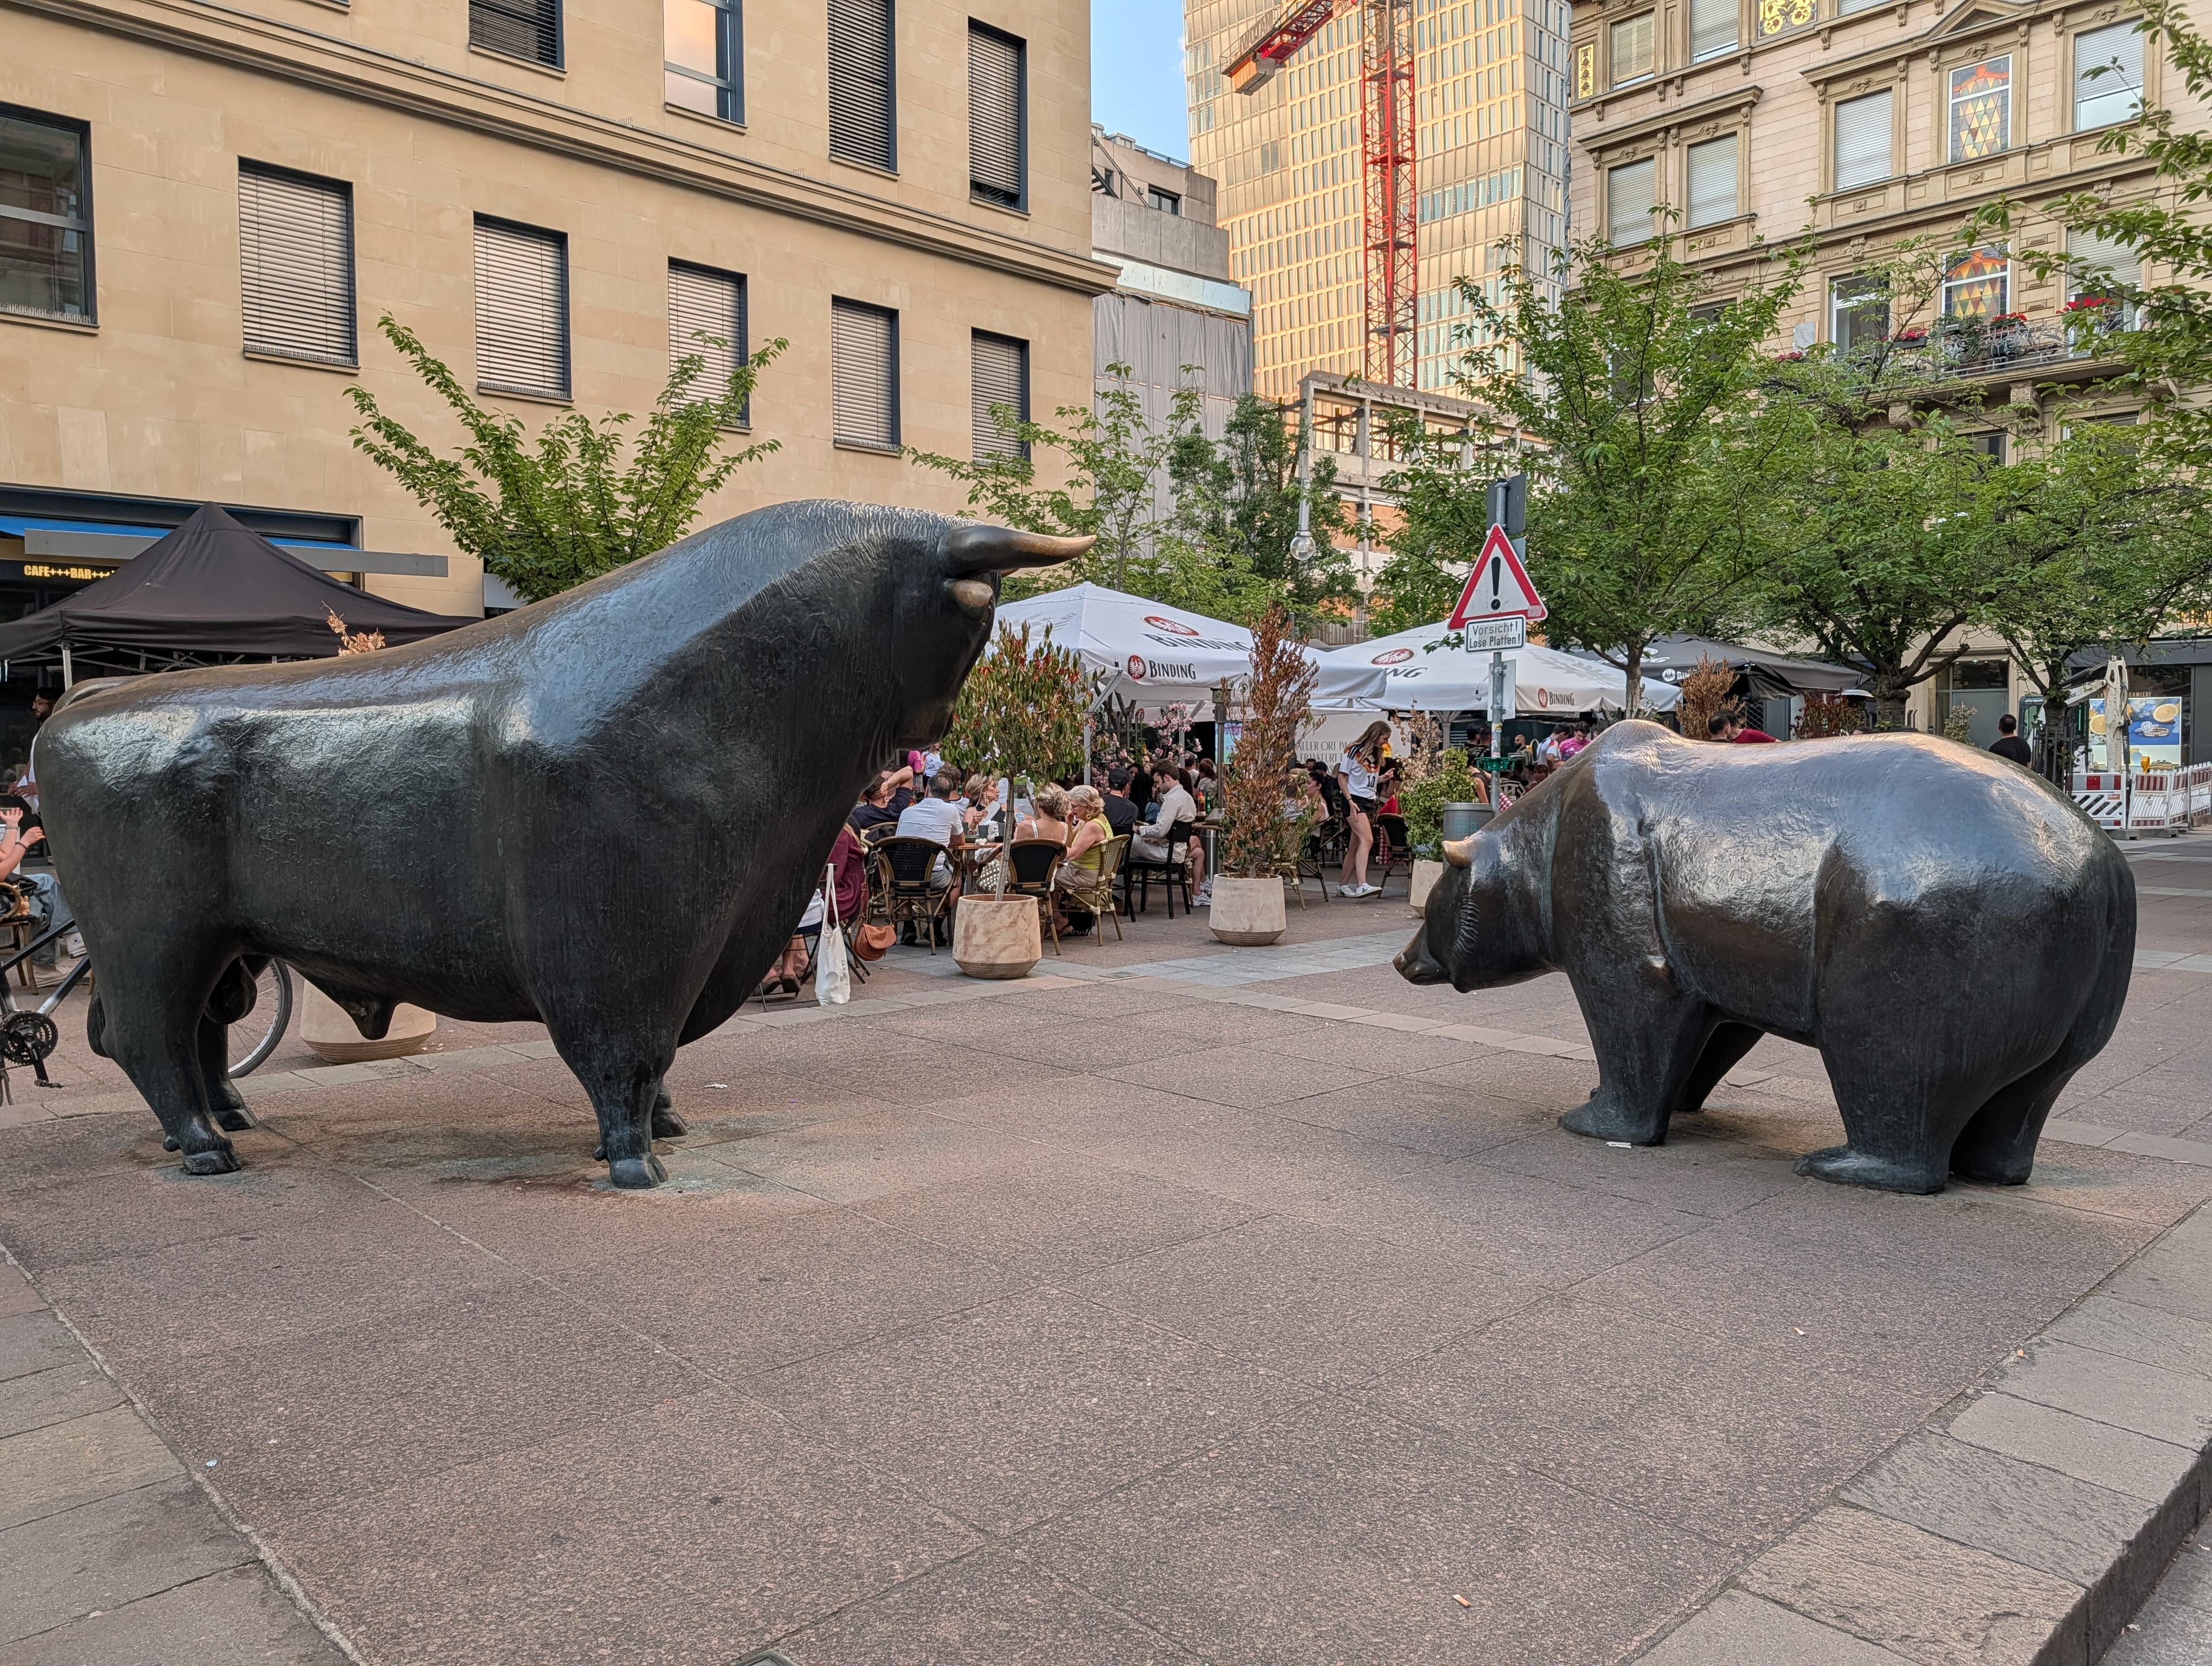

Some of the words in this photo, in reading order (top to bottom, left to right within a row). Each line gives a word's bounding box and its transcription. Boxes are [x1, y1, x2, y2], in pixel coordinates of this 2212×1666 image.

[1469, 638, 1487, 648] Lose
[1489, 633, 1520, 646] Platten!
[1148, 660, 1196, 680] BINDING
[1549, 691, 1574, 706] BINDING
[1321, 741, 1336, 751] ORT
[1367, 775, 1375, 787] 10
